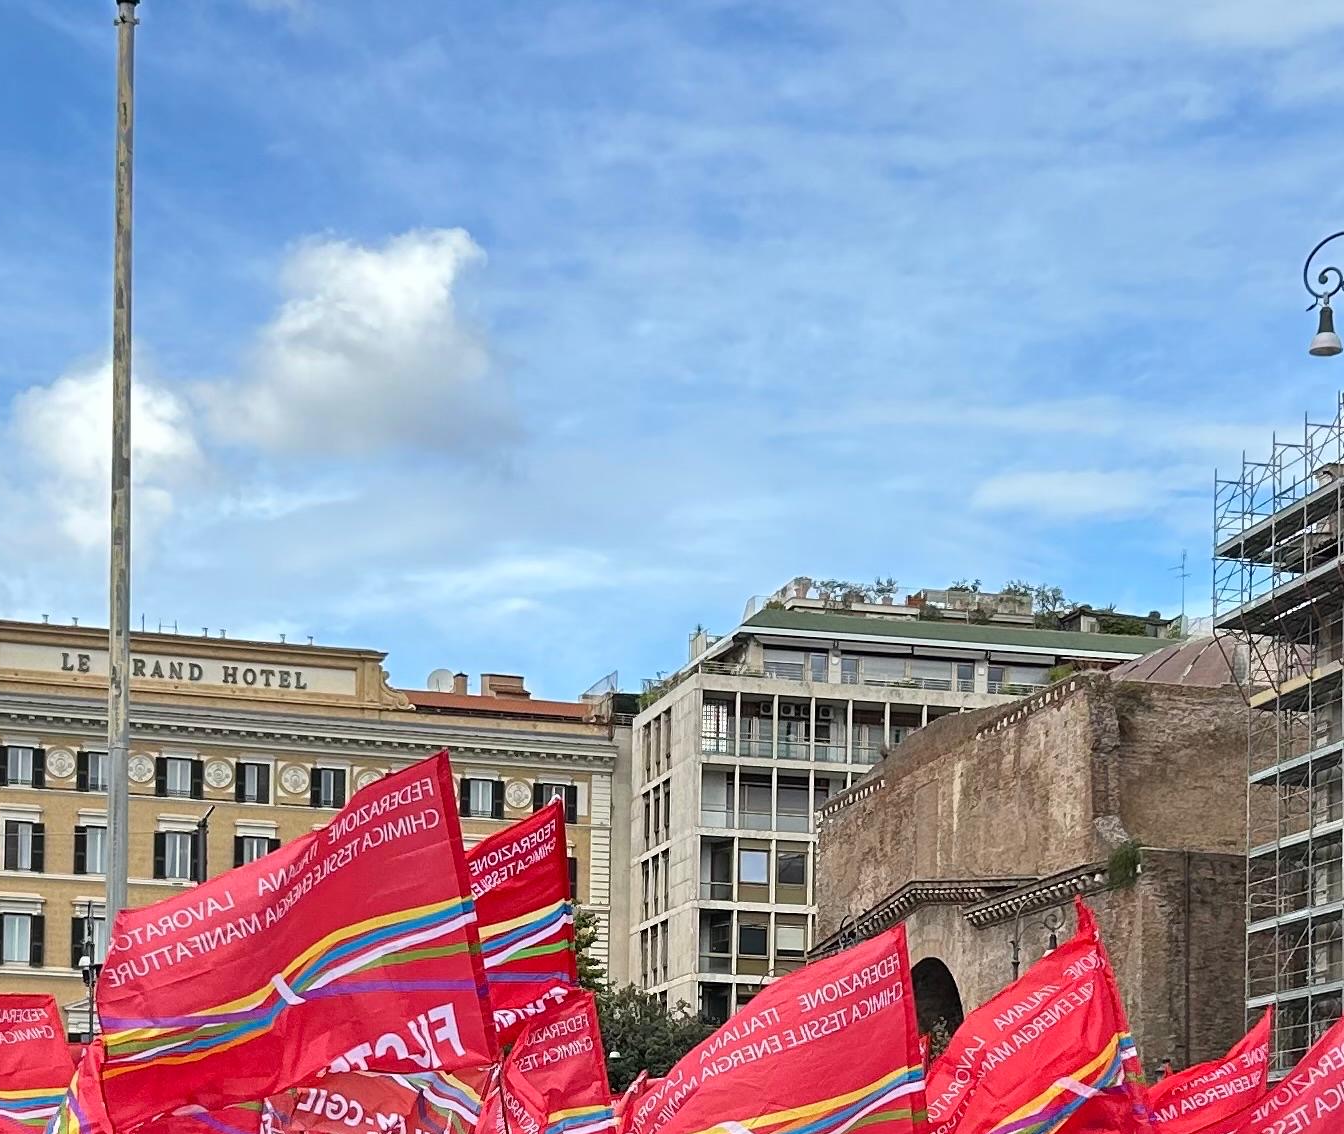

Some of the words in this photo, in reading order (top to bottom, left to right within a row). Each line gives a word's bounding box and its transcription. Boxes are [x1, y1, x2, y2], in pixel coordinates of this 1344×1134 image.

[61, 652, 90, 673] LE
[132, 658, 203, 683] RAND
[222, 669, 307, 692] HOTEL
